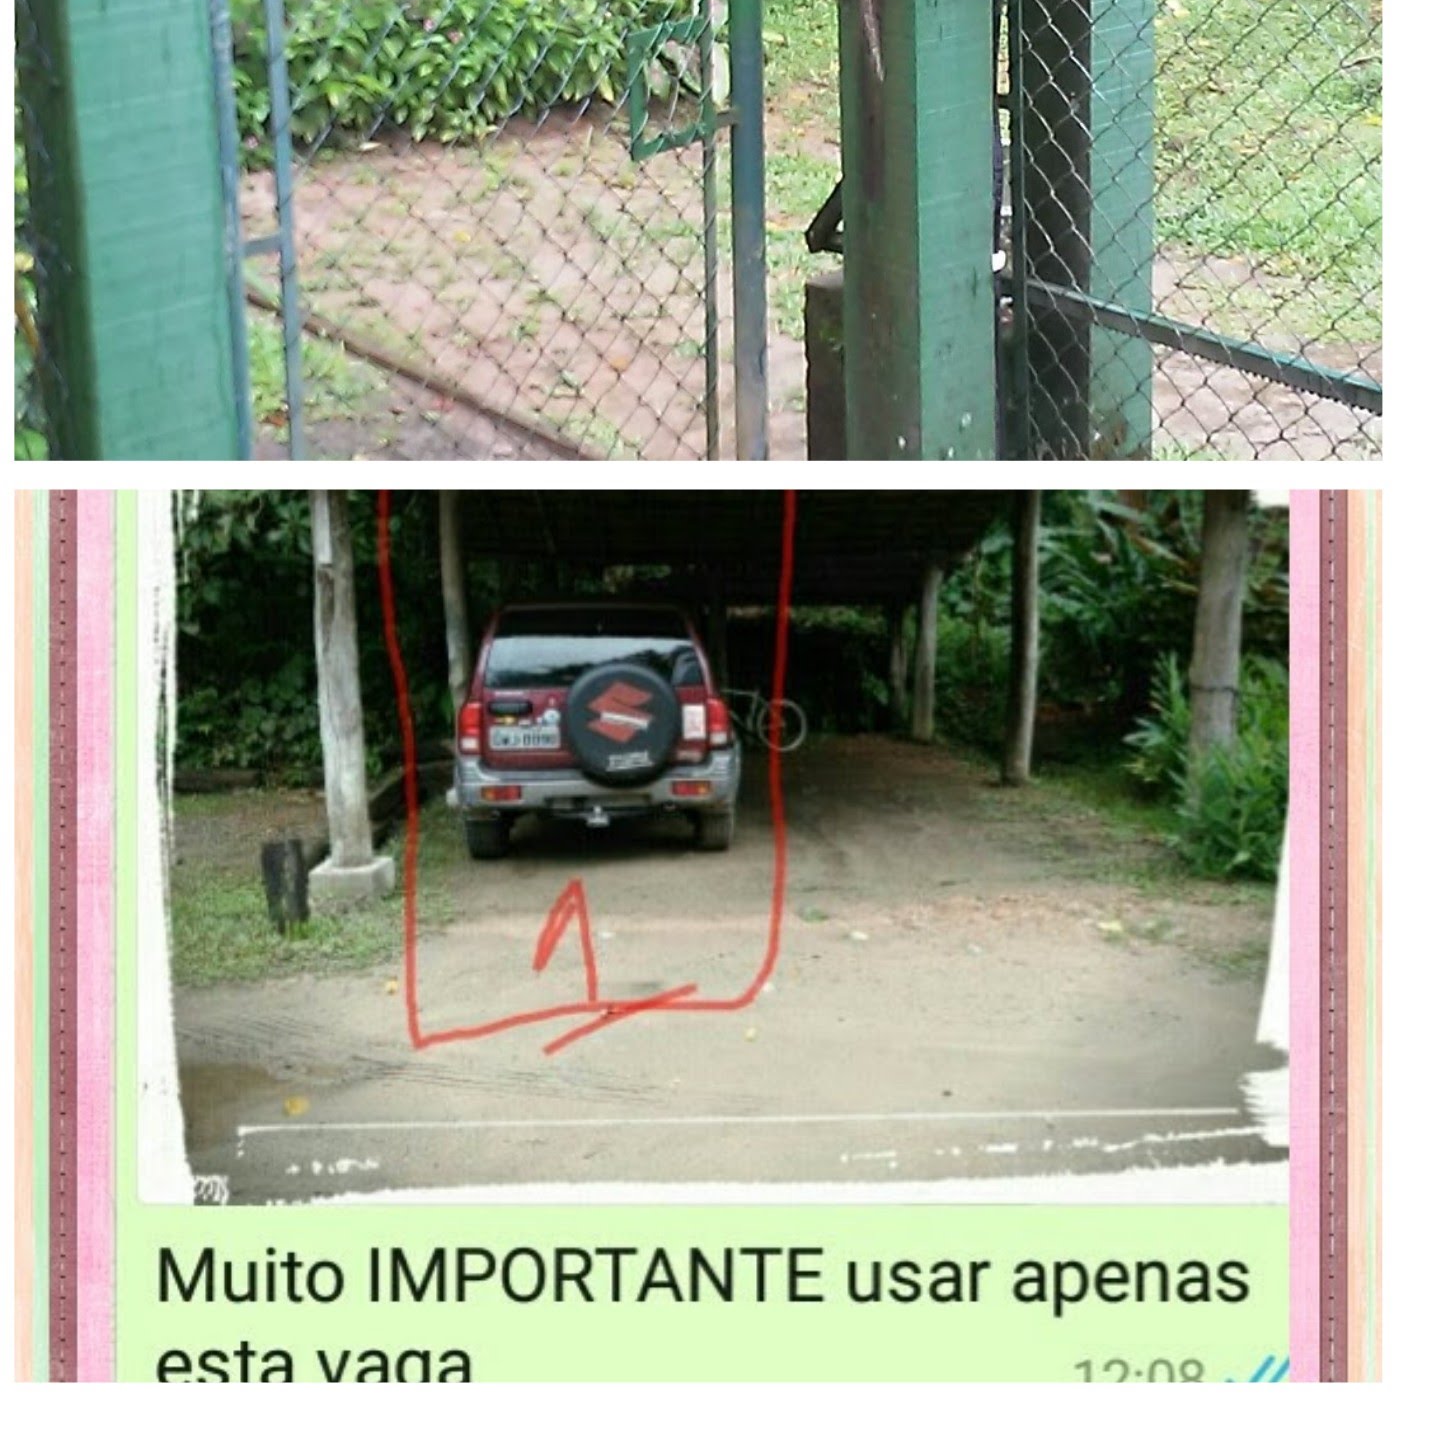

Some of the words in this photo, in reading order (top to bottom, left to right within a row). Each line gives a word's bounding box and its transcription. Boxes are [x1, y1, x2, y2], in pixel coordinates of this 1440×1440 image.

[159, 1246, 346, 1304] Muito
[369, 1246, 825, 1304] IMPORTANTE
[846, 1259, 992, 1304] usar
[1012, 1259, 1251, 1318] apenas
[156, 1340, 294, 1383] esta
[316, 1348, 472, 1383] vaga
